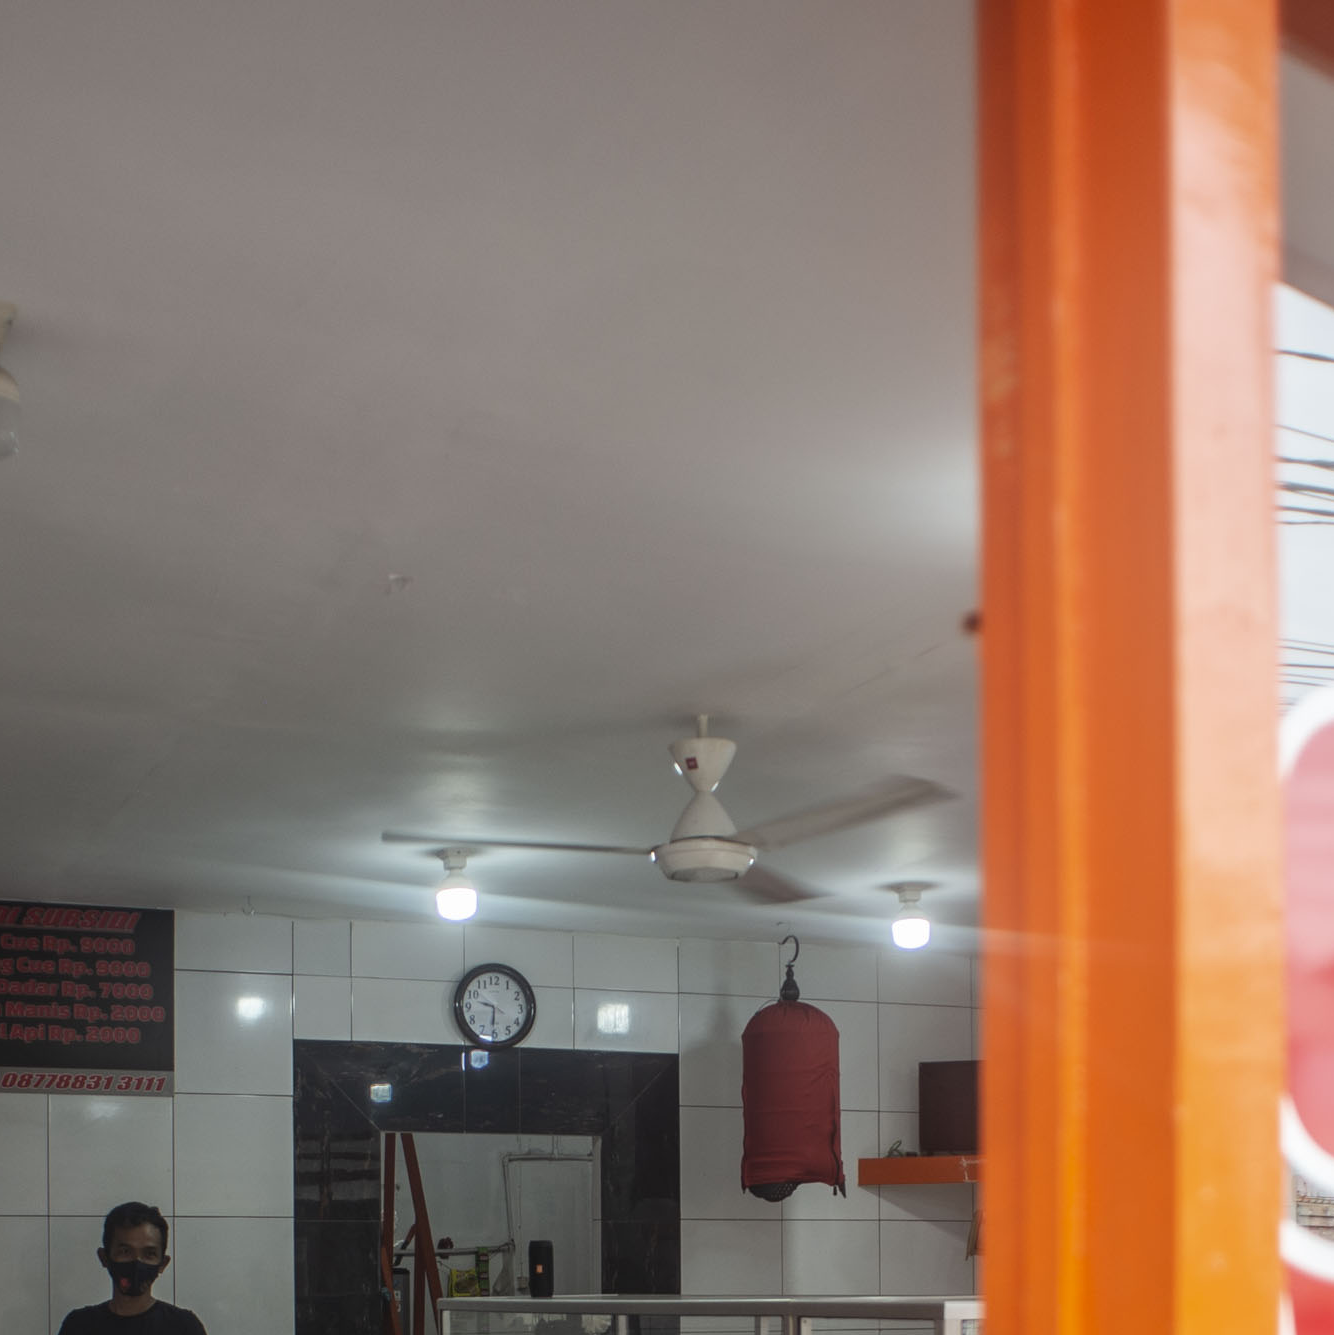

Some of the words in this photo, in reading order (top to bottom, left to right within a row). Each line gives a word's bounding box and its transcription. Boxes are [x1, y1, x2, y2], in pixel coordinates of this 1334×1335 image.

[21, 906, 141, 931] SUBSIDI
[489, 976, 500, 986] 12
[99, 982, 154, 1000] 7000
[5, 1002, 71, 1019] Manis
[110, 1005, 166, 1022] 2000
[9, 1024, 47, 1043] Api
[85, 1026, 142, 1043] 2000
